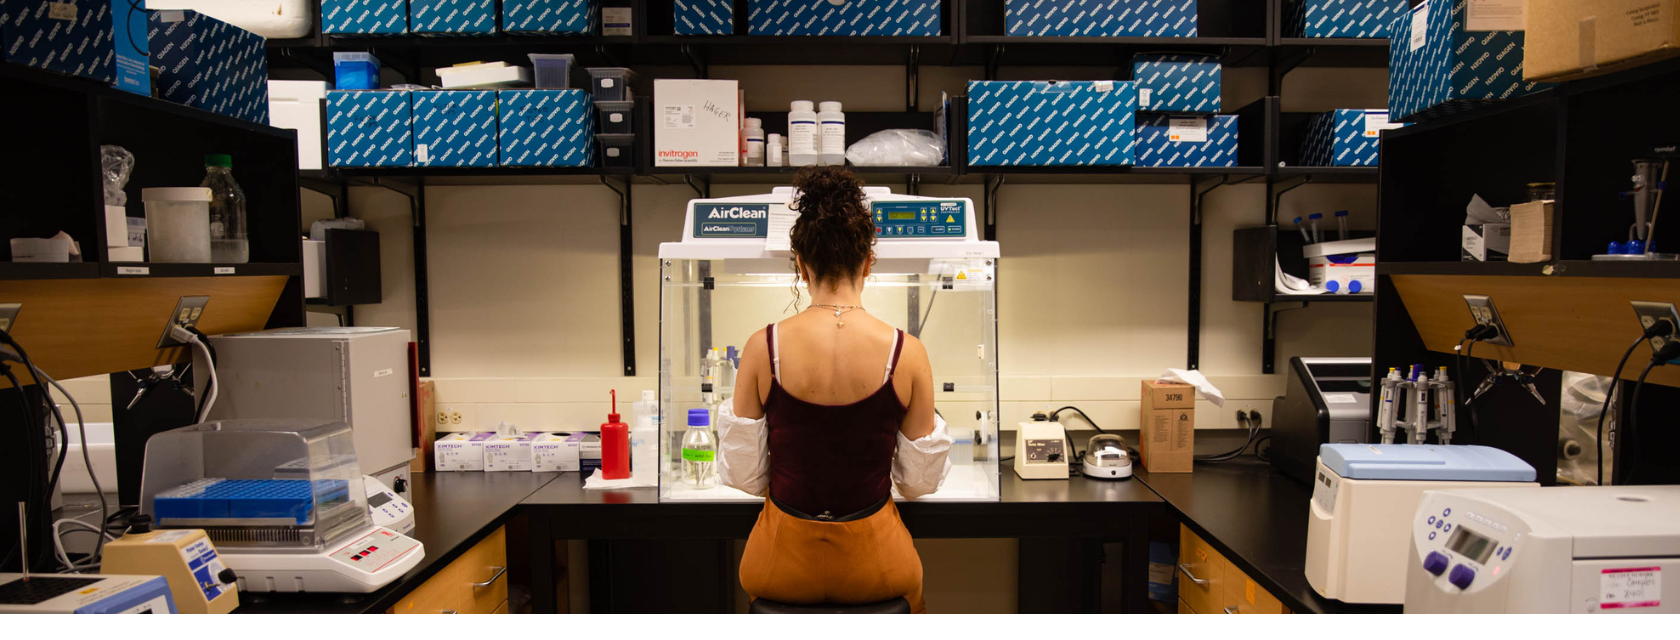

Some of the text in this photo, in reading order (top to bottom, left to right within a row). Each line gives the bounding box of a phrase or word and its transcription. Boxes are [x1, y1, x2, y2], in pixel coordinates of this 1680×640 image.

[1456, 37, 1475, 55] QIAGEN
[1496, 42, 1515, 60] QIAGEN
[1470, 52, 1489, 70] QIAGEN
[1460, 76, 1479, 94] QIAGEN
[1485, 67, 1504, 85] QIAGEN
[703, 100, 731, 122] HAGER
[658, 149, 698, 159] invitrogen
[708, 207, 766, 219] AirClean
